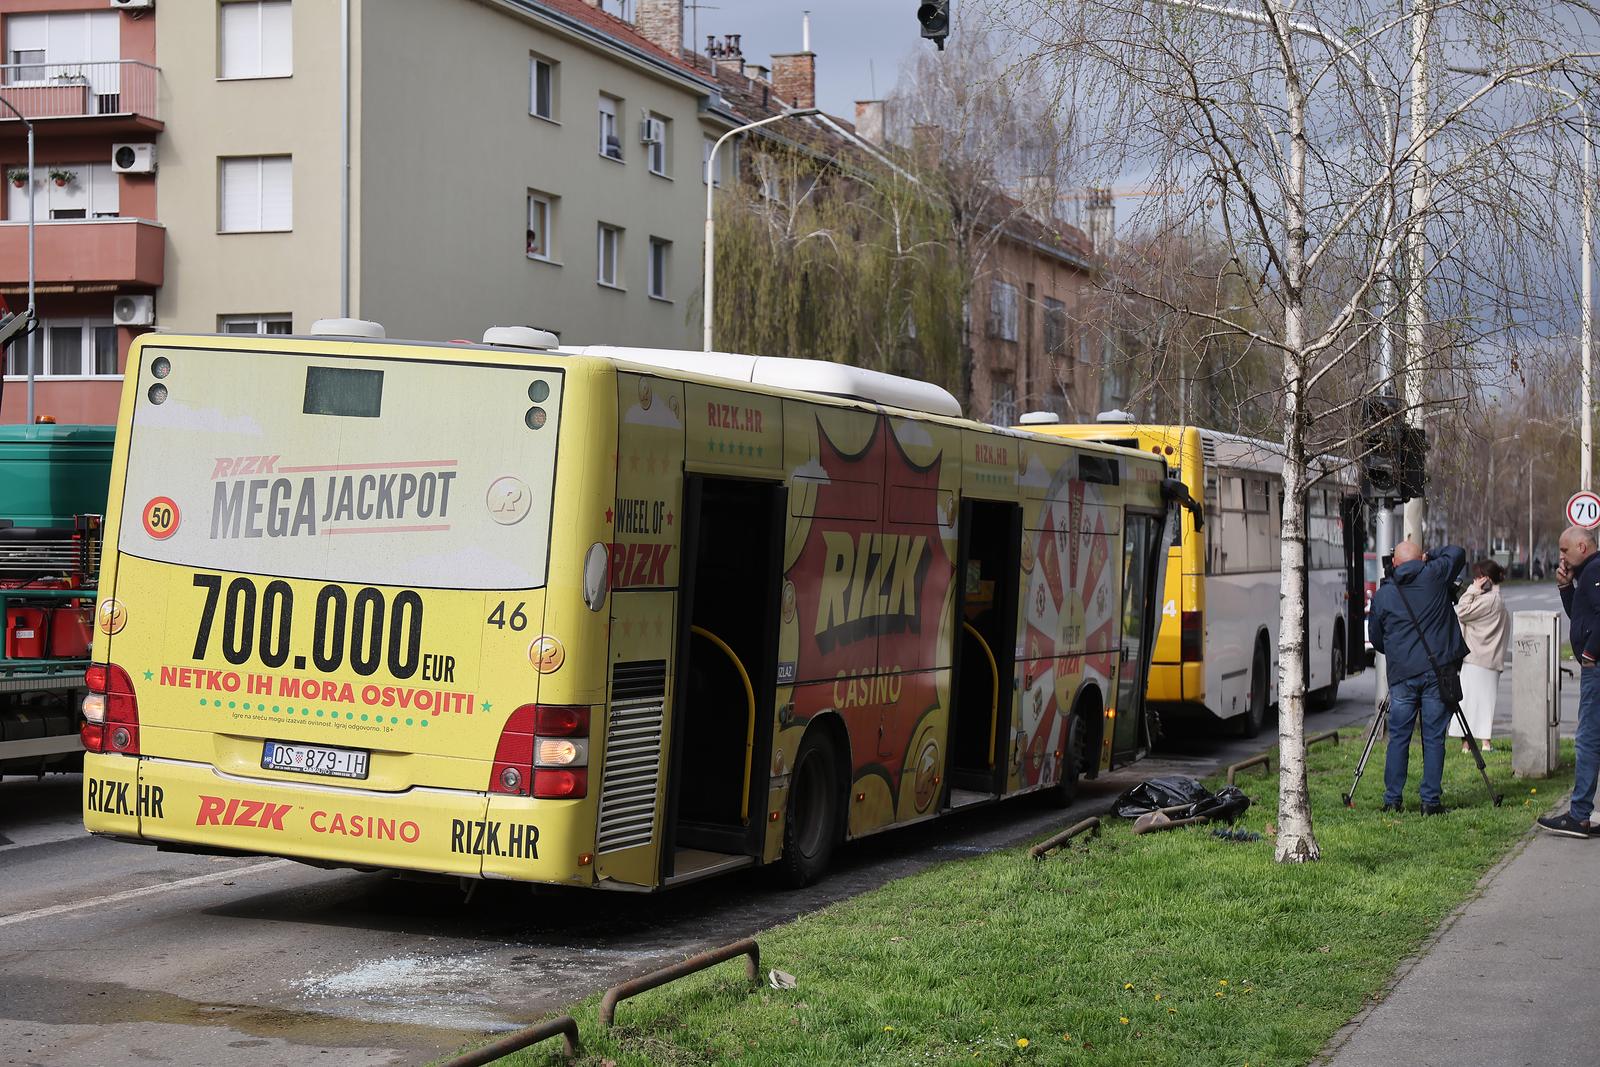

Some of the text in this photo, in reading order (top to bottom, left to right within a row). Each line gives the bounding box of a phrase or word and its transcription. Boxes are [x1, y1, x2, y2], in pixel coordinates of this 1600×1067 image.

[707, 402, 762, 434] RIZK.HR
[211, 455, 280, 480] RIZK
[151, 506, 172, 529] 50
[210, 472, 456, 540] MEGA JACKPOT
[616, 498, 665, 534] WHEEL OF
[1575, 503, 1597, 520] 70
[606, 543, 672, 592] RIZK
[815, 531, 927, 637] RIZK
[192, 574, 455, 683] 700.000 EUR
[487, 601, 528, 632] 46
[159, 666, 475, 716] NETKO IH MORA OSVOJITI
[833, 665, 902, 709] CASINO
[348, 724, 381, 732] odgovorno.
[274, 746, 366, 774] OS 879-IH
[88, 778, 164, 818] RIZK.HR
[196, 795, 421, 844] RIZK CASINO
[452, 819, 540, 859] RIZK.HR
